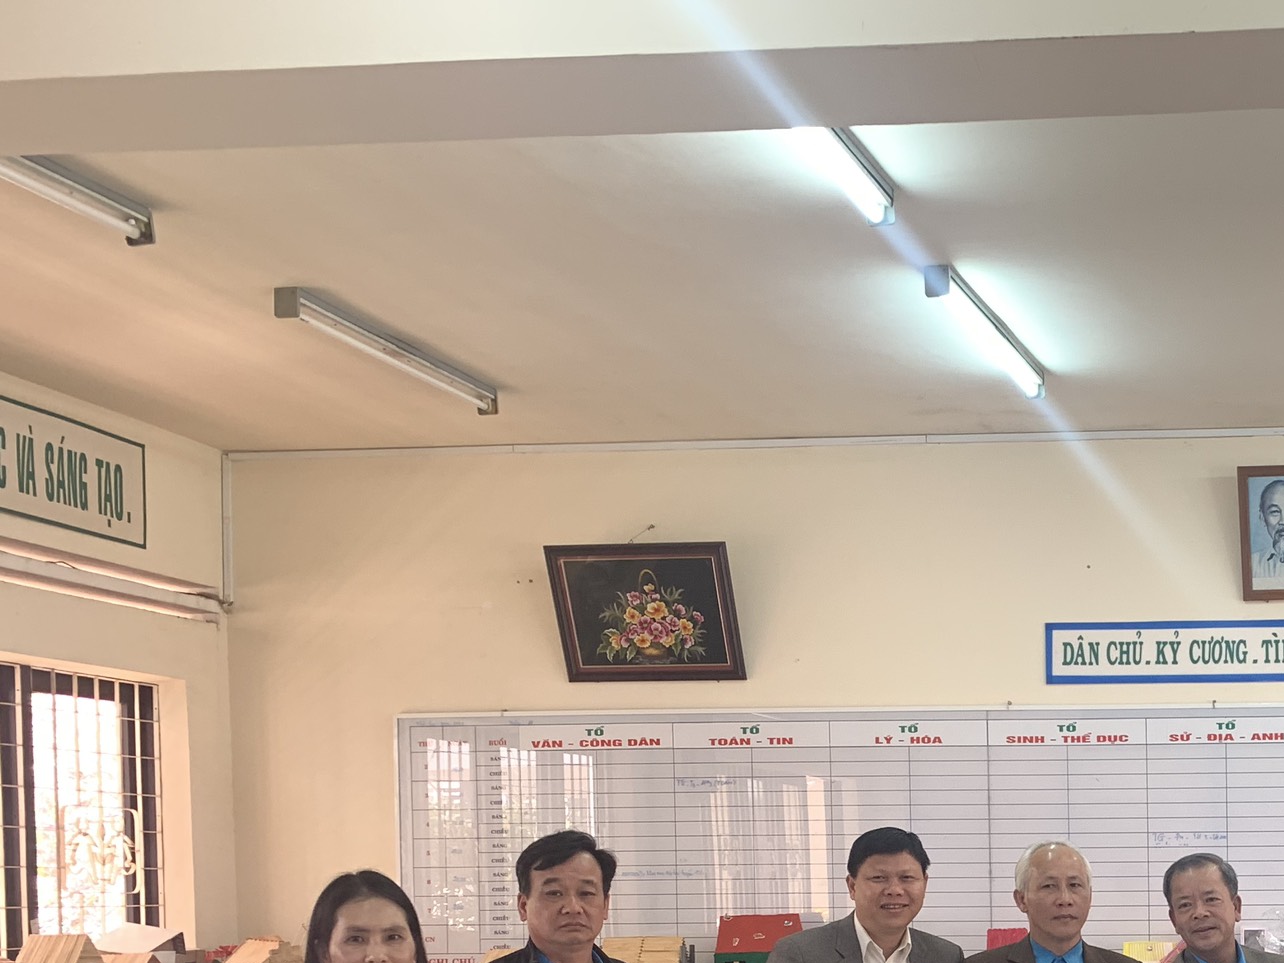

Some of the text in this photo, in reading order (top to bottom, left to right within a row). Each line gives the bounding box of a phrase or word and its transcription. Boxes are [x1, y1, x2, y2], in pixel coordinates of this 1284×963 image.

[16, 425, 37, 497] VÀ
[45, 436, 88, 511] SÁNG
[95, 458, 131, 528] TẠO.
[1062, 635, 1100, 666] DÂN
[1155, 631, 1181, 665] KỶ
[585, 725, 604, 737] TỔ
[740, 724, 761, 735] TỔ
[898, 722, 919, 734] TỔ
[1057, 721, 1078, 733] TỔ
[1216, 719, 1237, 731] TỔ
[531, 738, 563, 749] VĂN
[579, 737, 623, 748] CÔNG
[627, 736, 661, 747] DÂN
[708, 737, 752, 746] TOÁN
[767, 737, 794, 746] TIN
[874, 734, 893, 745] LÝ
[909, 735, 943, 745] HÓA
[1005, 734, 1045, 744] SINH
[1061, 732, 1093, 744] THỂ
[1096, 734, 1129, 745] DỤC
[1168, 731, 1193, 742] SỬ
[1206, 733, 1235, 743] ĐỊA
[1250, 732, 1284, 741] ANH
